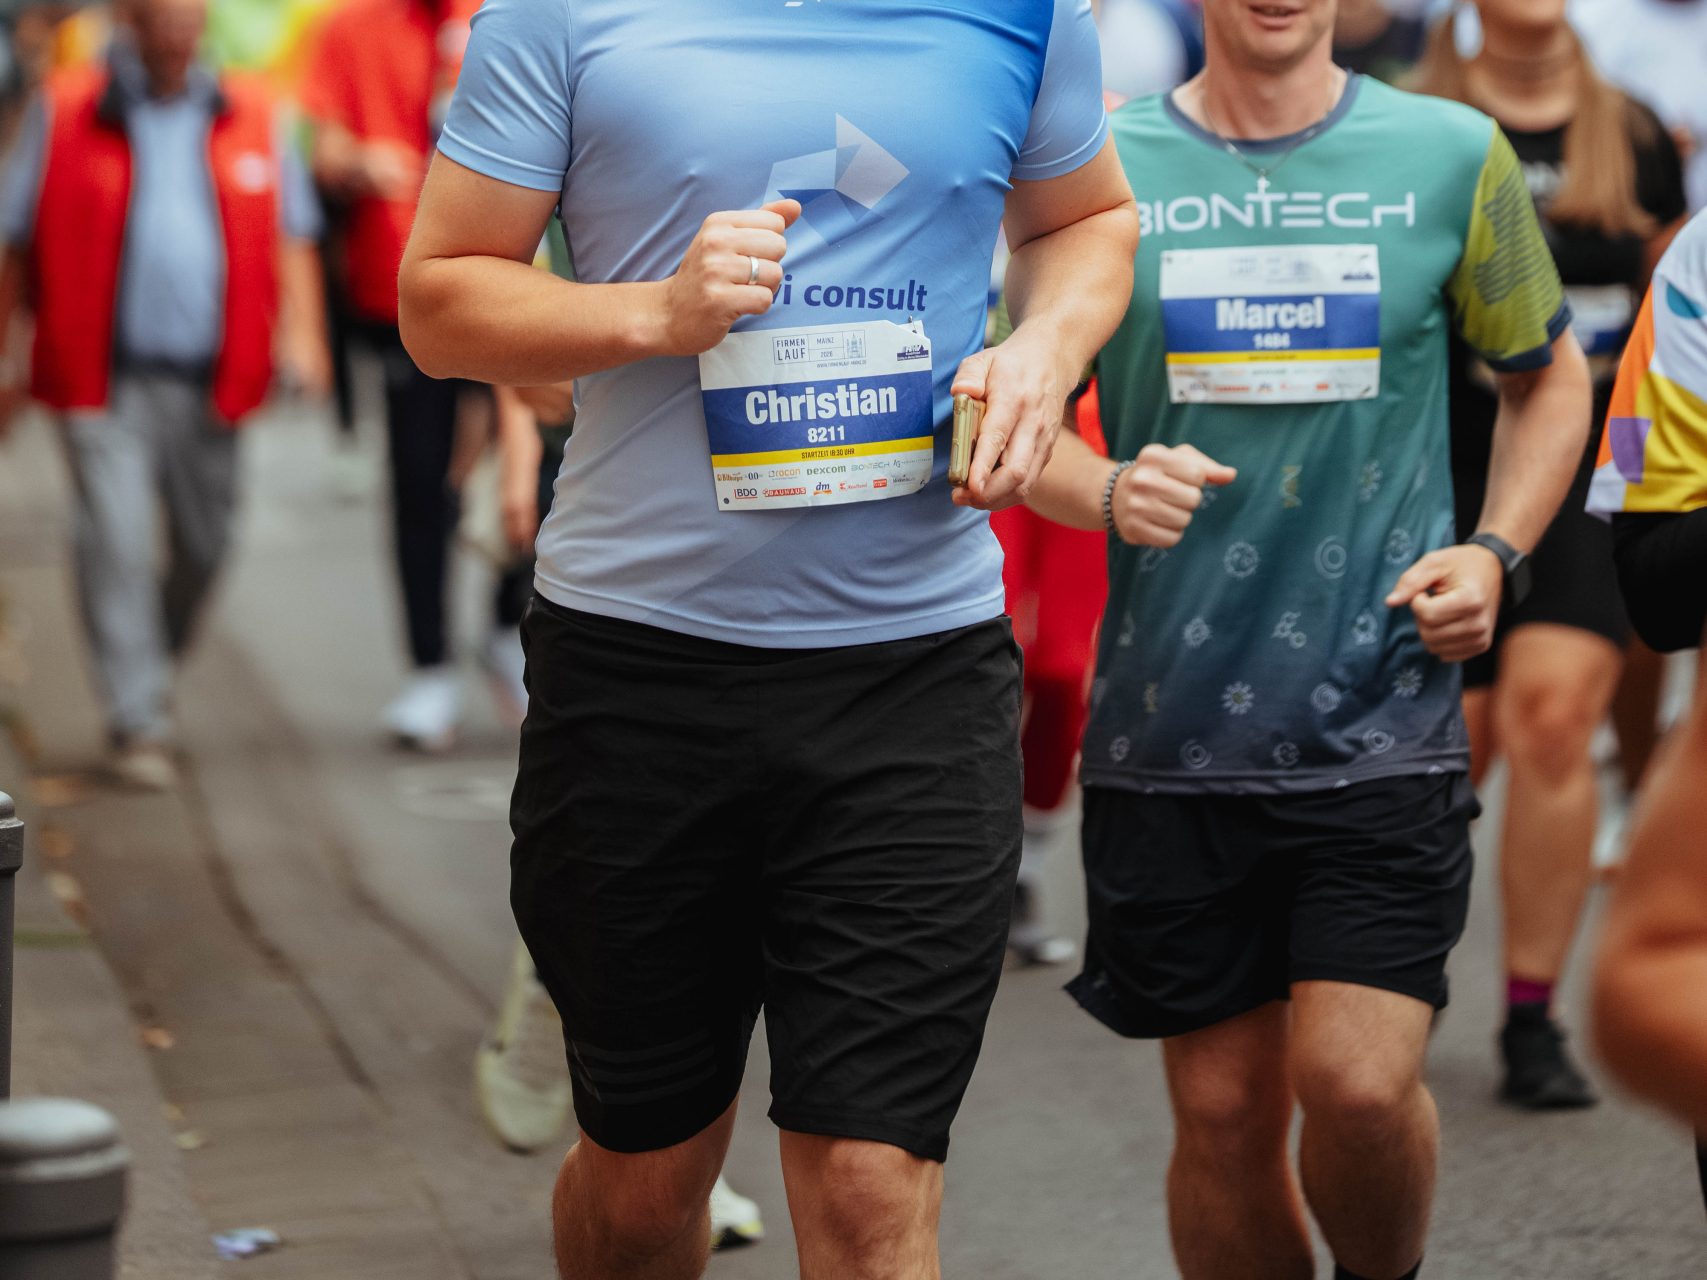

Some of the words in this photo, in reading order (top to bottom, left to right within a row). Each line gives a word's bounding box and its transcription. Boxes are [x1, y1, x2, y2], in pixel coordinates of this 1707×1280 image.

[804, 279, 928, 312] consult
[1215, 295, 1326, 332] Marcel
[776, 337, 806, 348] FIRMEN
[777, 348, 806, 361] LAUF
[745, 383, 898, 426] Christian
[807, 425, 845, 443] 8211
[801, 450, 829, 459] STARTZEIT
[768, 487, 806, 496] BAUHAUS
[815, 481, 830, 491] dm
[737, 488, 758, 497] BDO
